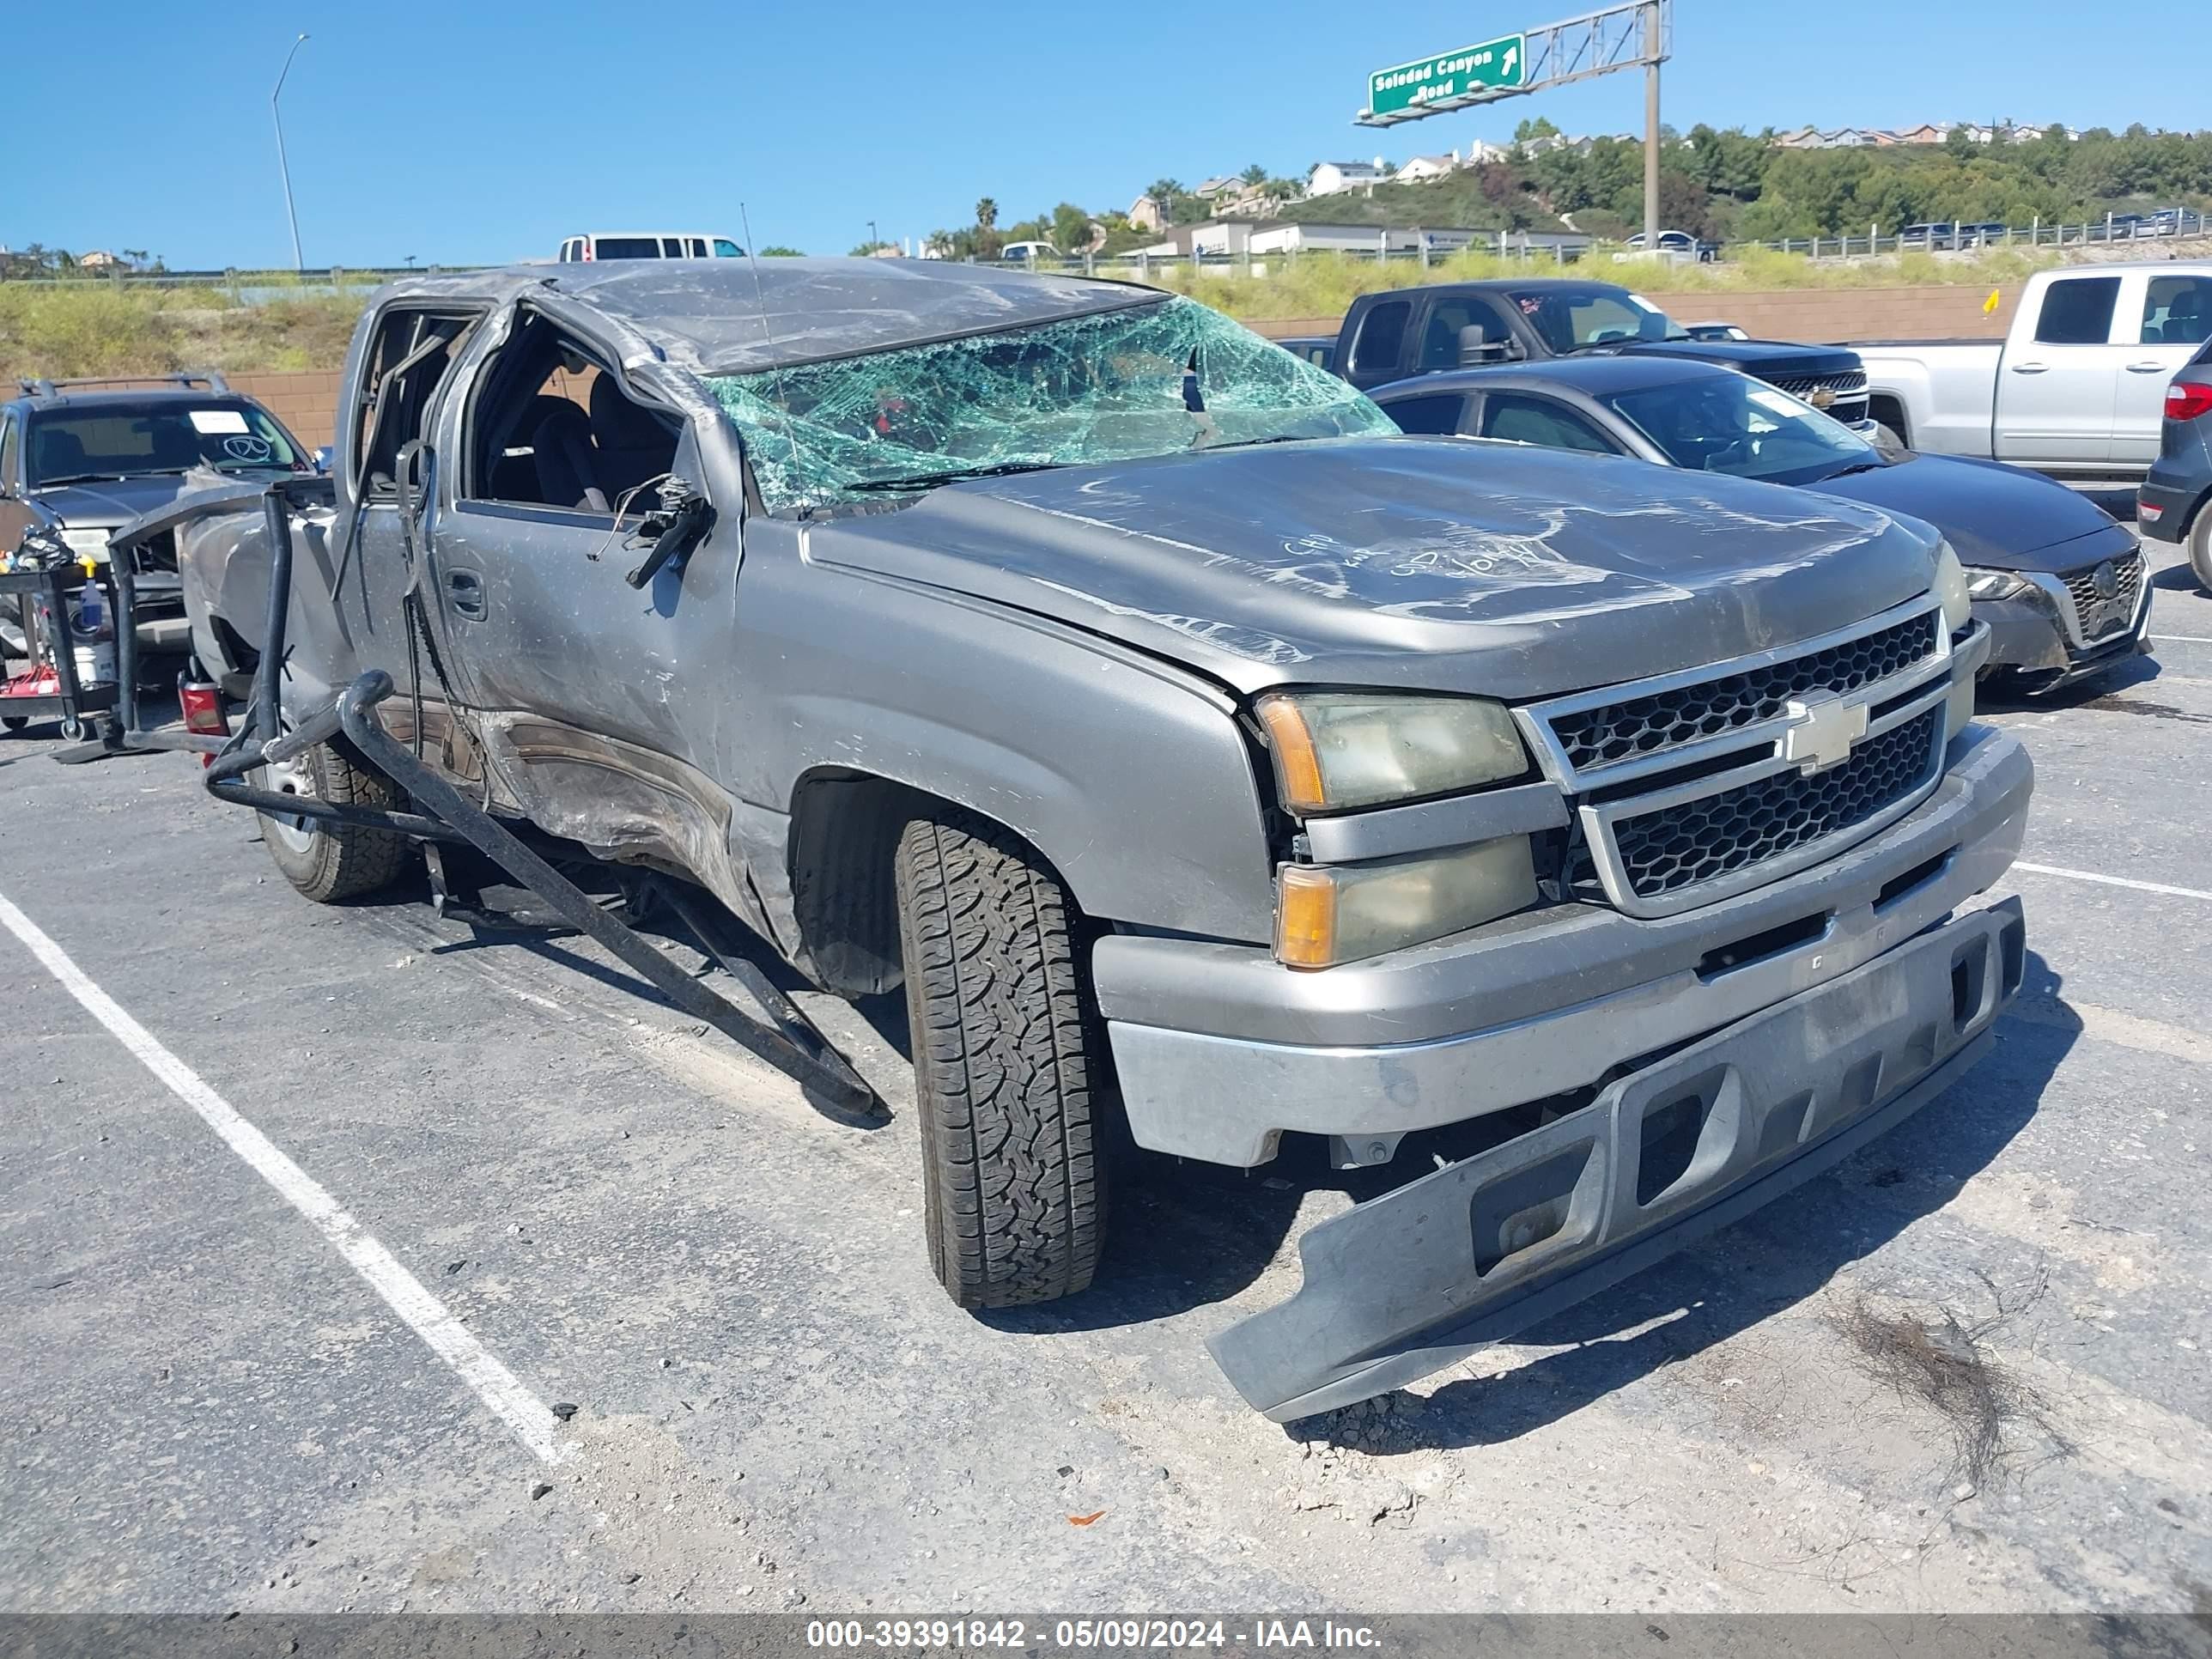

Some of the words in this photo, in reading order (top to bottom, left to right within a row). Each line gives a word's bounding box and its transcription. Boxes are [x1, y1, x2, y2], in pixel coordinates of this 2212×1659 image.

[1375, 64, 1432, 92] Soledad
[1437, 51, 1493, 76] Canyon
[1417, 78, 1455, 100] Road
[1284, 534, 1341, 556] CHP
